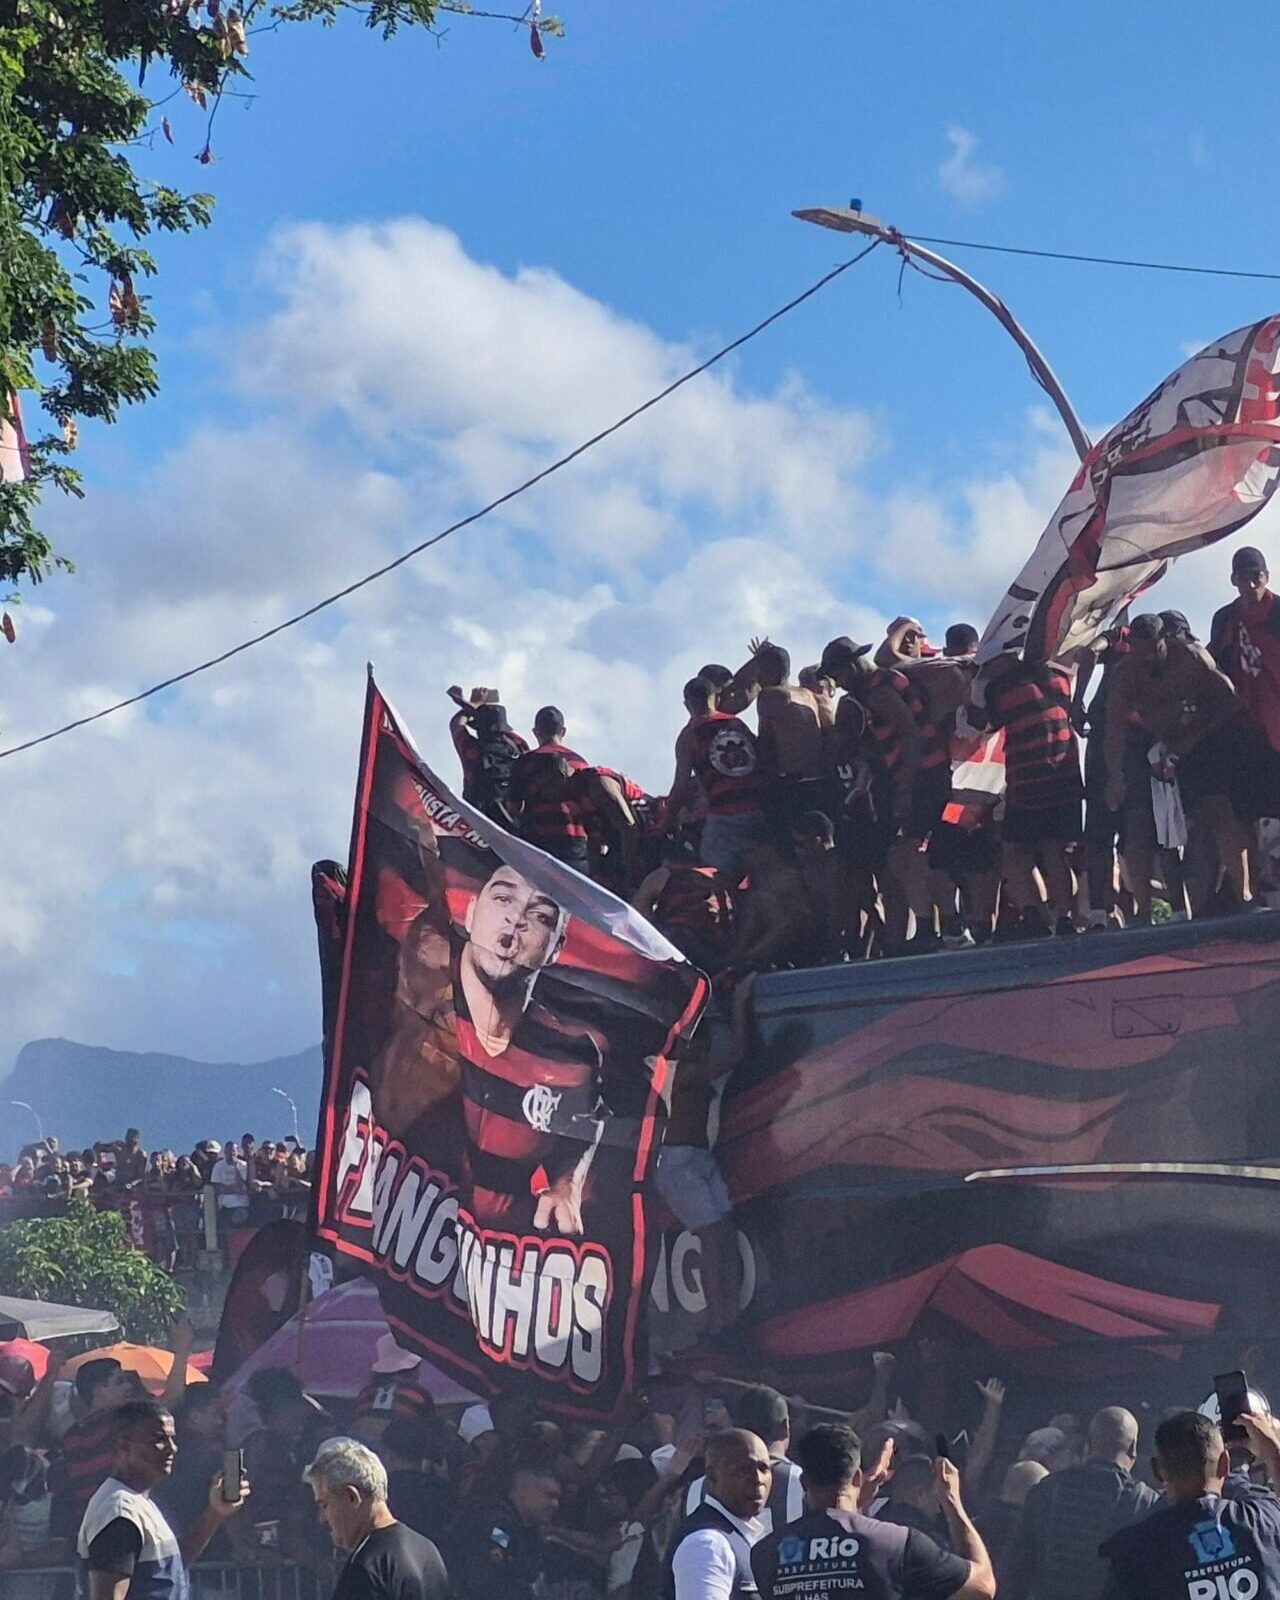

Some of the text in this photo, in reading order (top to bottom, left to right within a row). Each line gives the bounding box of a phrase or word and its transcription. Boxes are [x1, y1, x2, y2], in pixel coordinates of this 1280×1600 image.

[777, 1560, 858, 1575] PREFEITURA
[1184, 1555, 1252, 1579] PREFEITURA
[772, 1578, 865, 1597] SUBPREFEITURA
